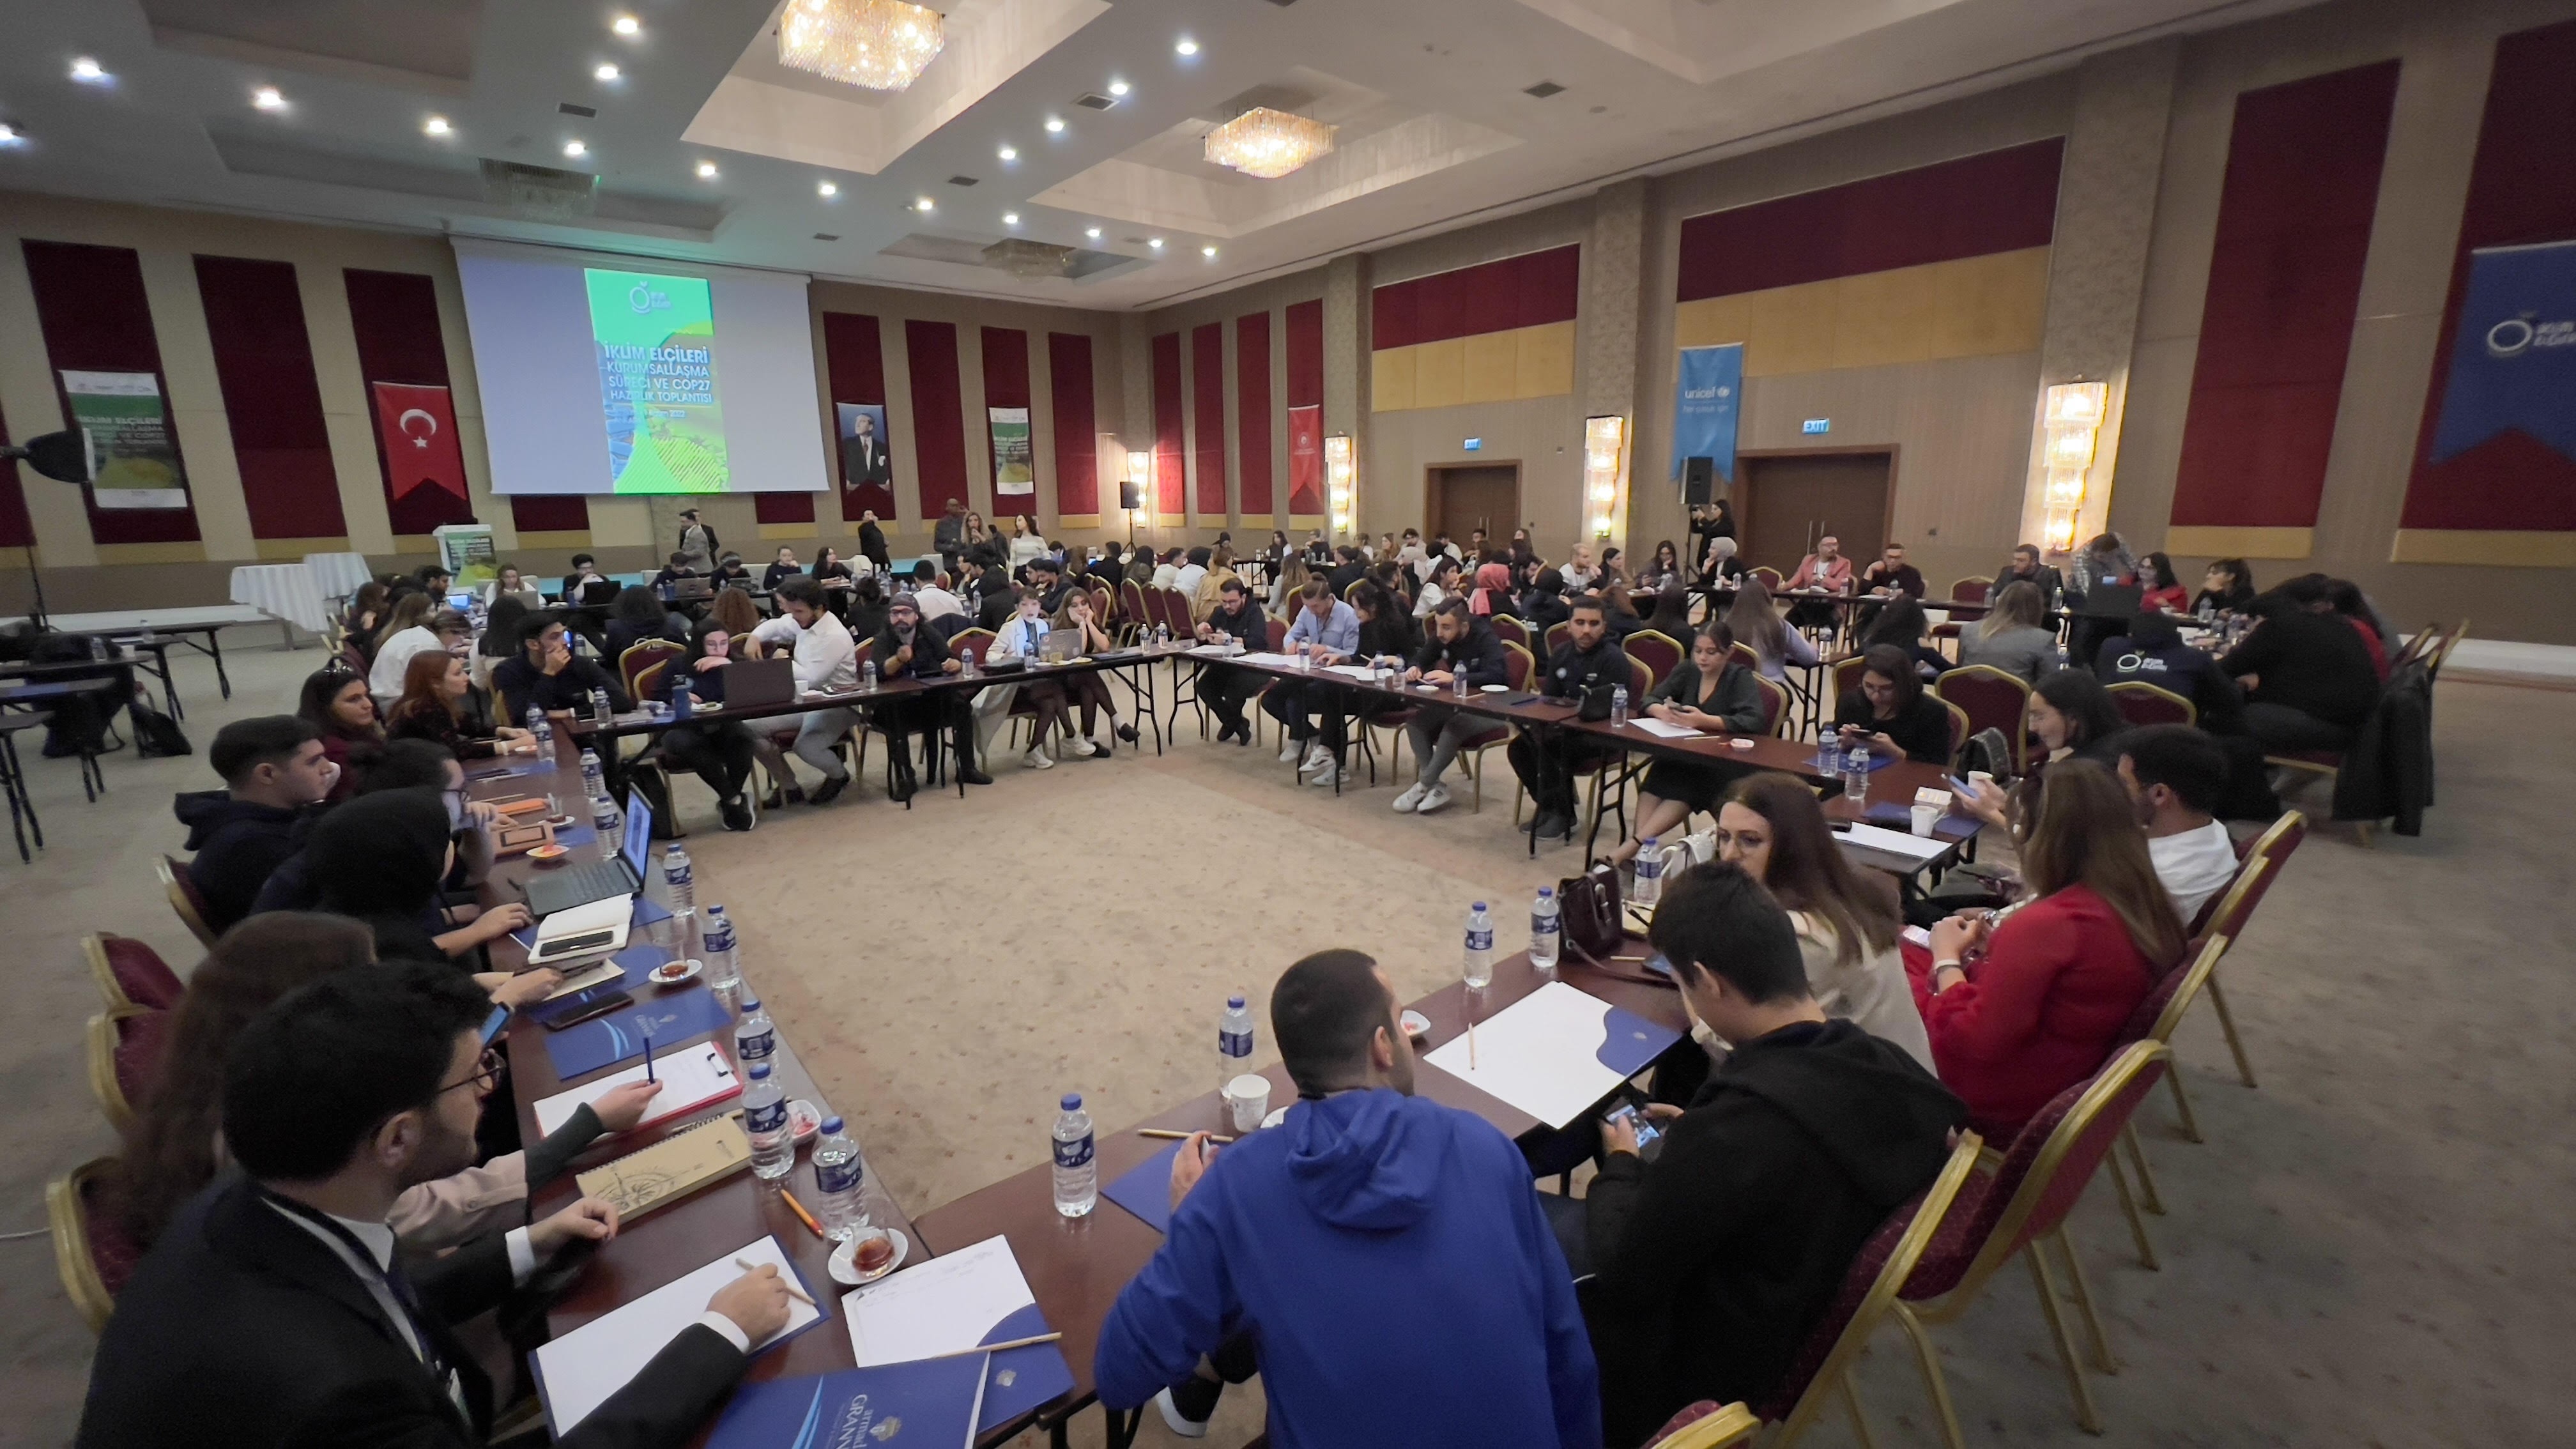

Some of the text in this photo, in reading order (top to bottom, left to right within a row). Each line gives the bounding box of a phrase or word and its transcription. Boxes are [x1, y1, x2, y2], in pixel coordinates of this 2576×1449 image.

[650, 344, 709, 364] ELÇİLERİ
[654, 378, 670, 389] VE
[672, 379, 710, 391] COP27
[1685, 386, 1717, 399] unicef
[1805, 420, 1827, 431] EXIT
